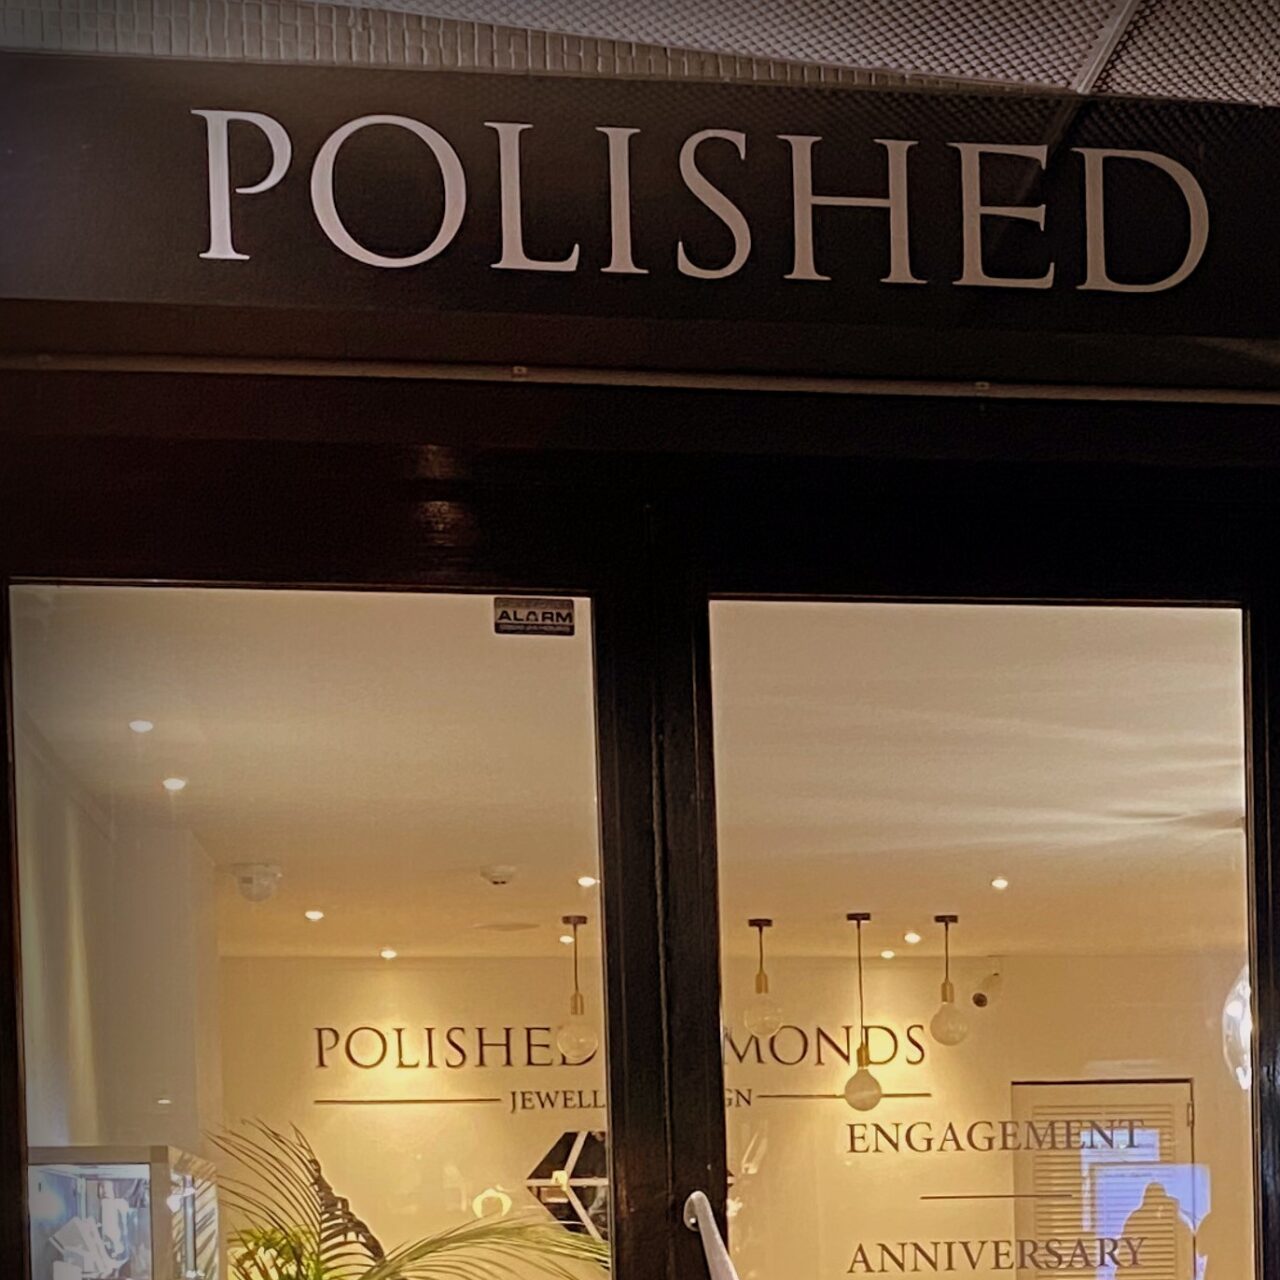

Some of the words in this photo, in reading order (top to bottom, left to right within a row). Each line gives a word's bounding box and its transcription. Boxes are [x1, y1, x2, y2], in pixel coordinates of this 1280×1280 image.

[191, 108, 1210, 293] POLISHED
[497, 610, 573, 623] ALARM
[723, 1024, 925, 1066] MONDS
[509, 1089, 605, 1113] JEWELL
[846, 1118, 1144, 1154] ENGAGEMENT
[846, 1236, 1148, 1274] ANNIVERSARY
